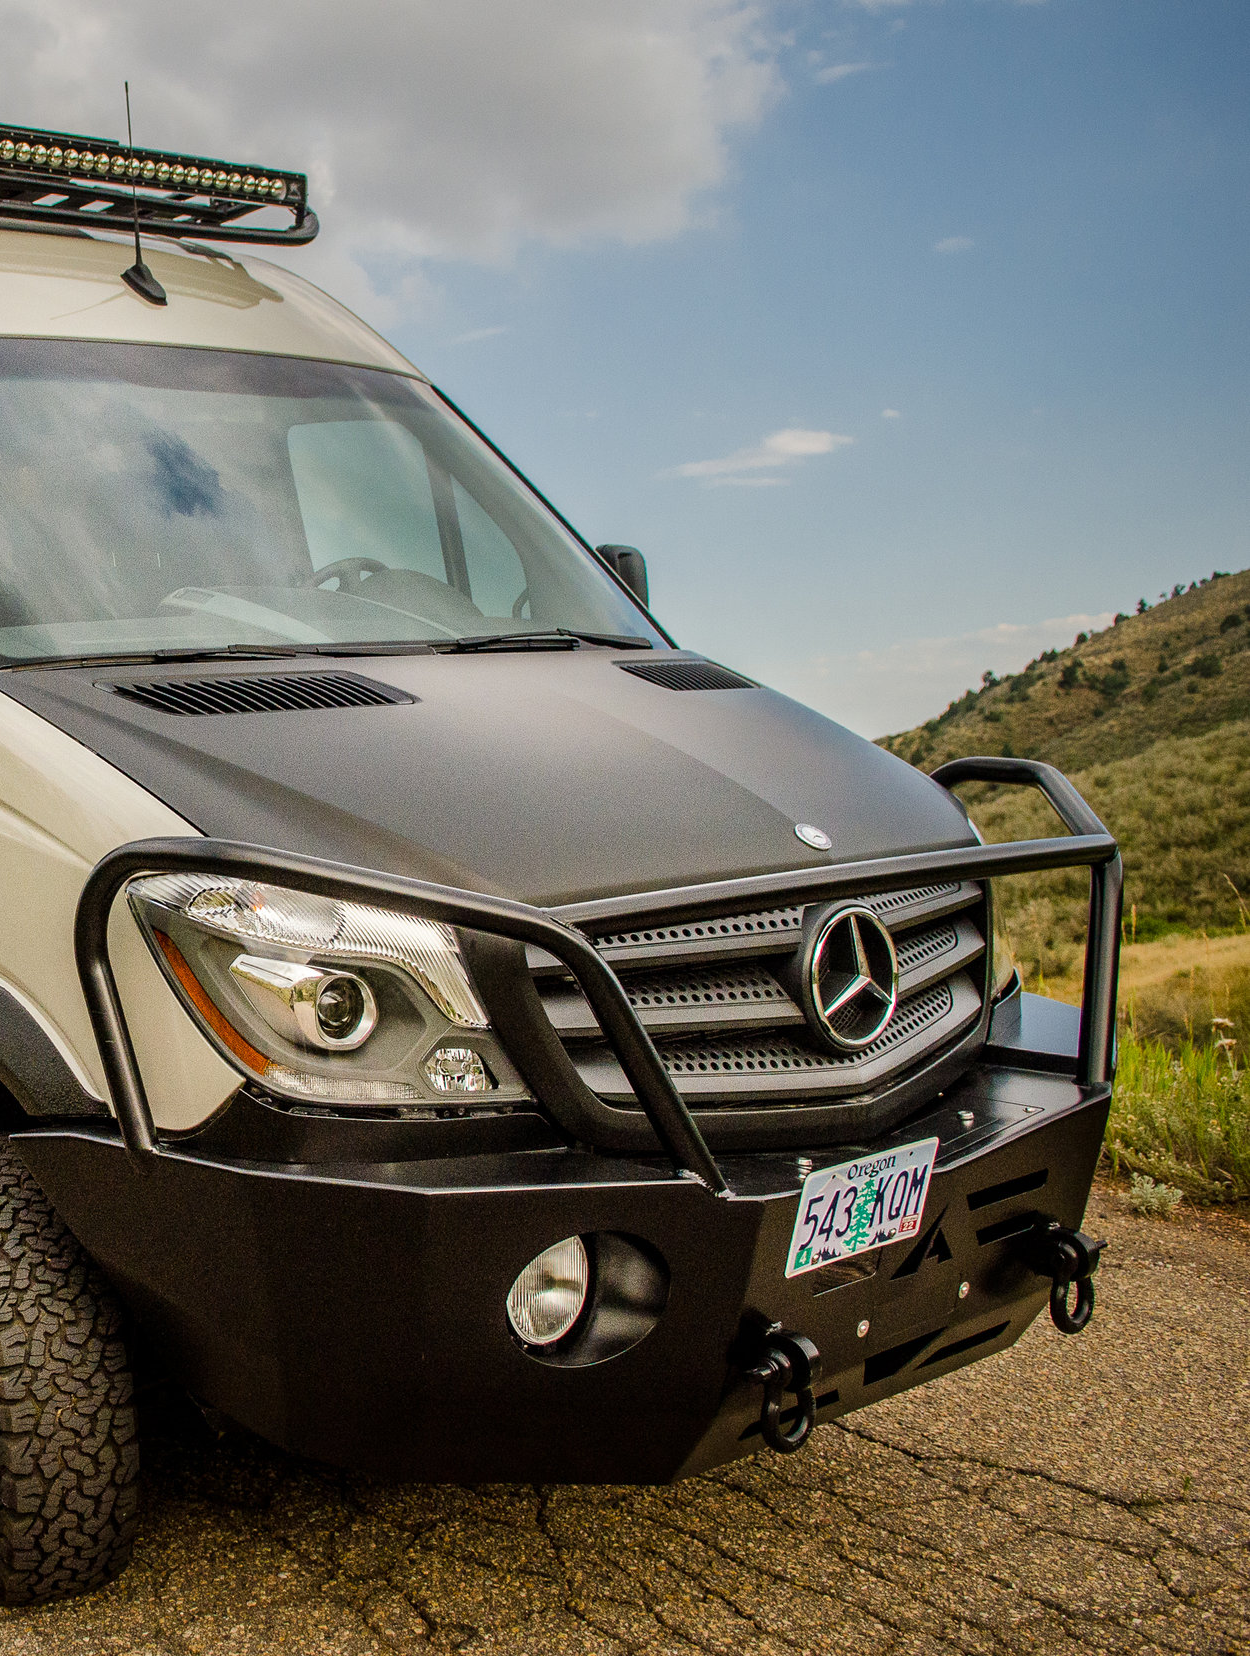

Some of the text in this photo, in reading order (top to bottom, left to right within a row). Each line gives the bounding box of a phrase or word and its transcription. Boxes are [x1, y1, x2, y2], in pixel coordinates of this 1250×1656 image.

[847, 1155, 896, 1180] Oregon
[798, 1164, 928, 1251] 543 KQM
[902, 1221, 914, 1231] 22
[799, 1250, 807, 1264] 4
